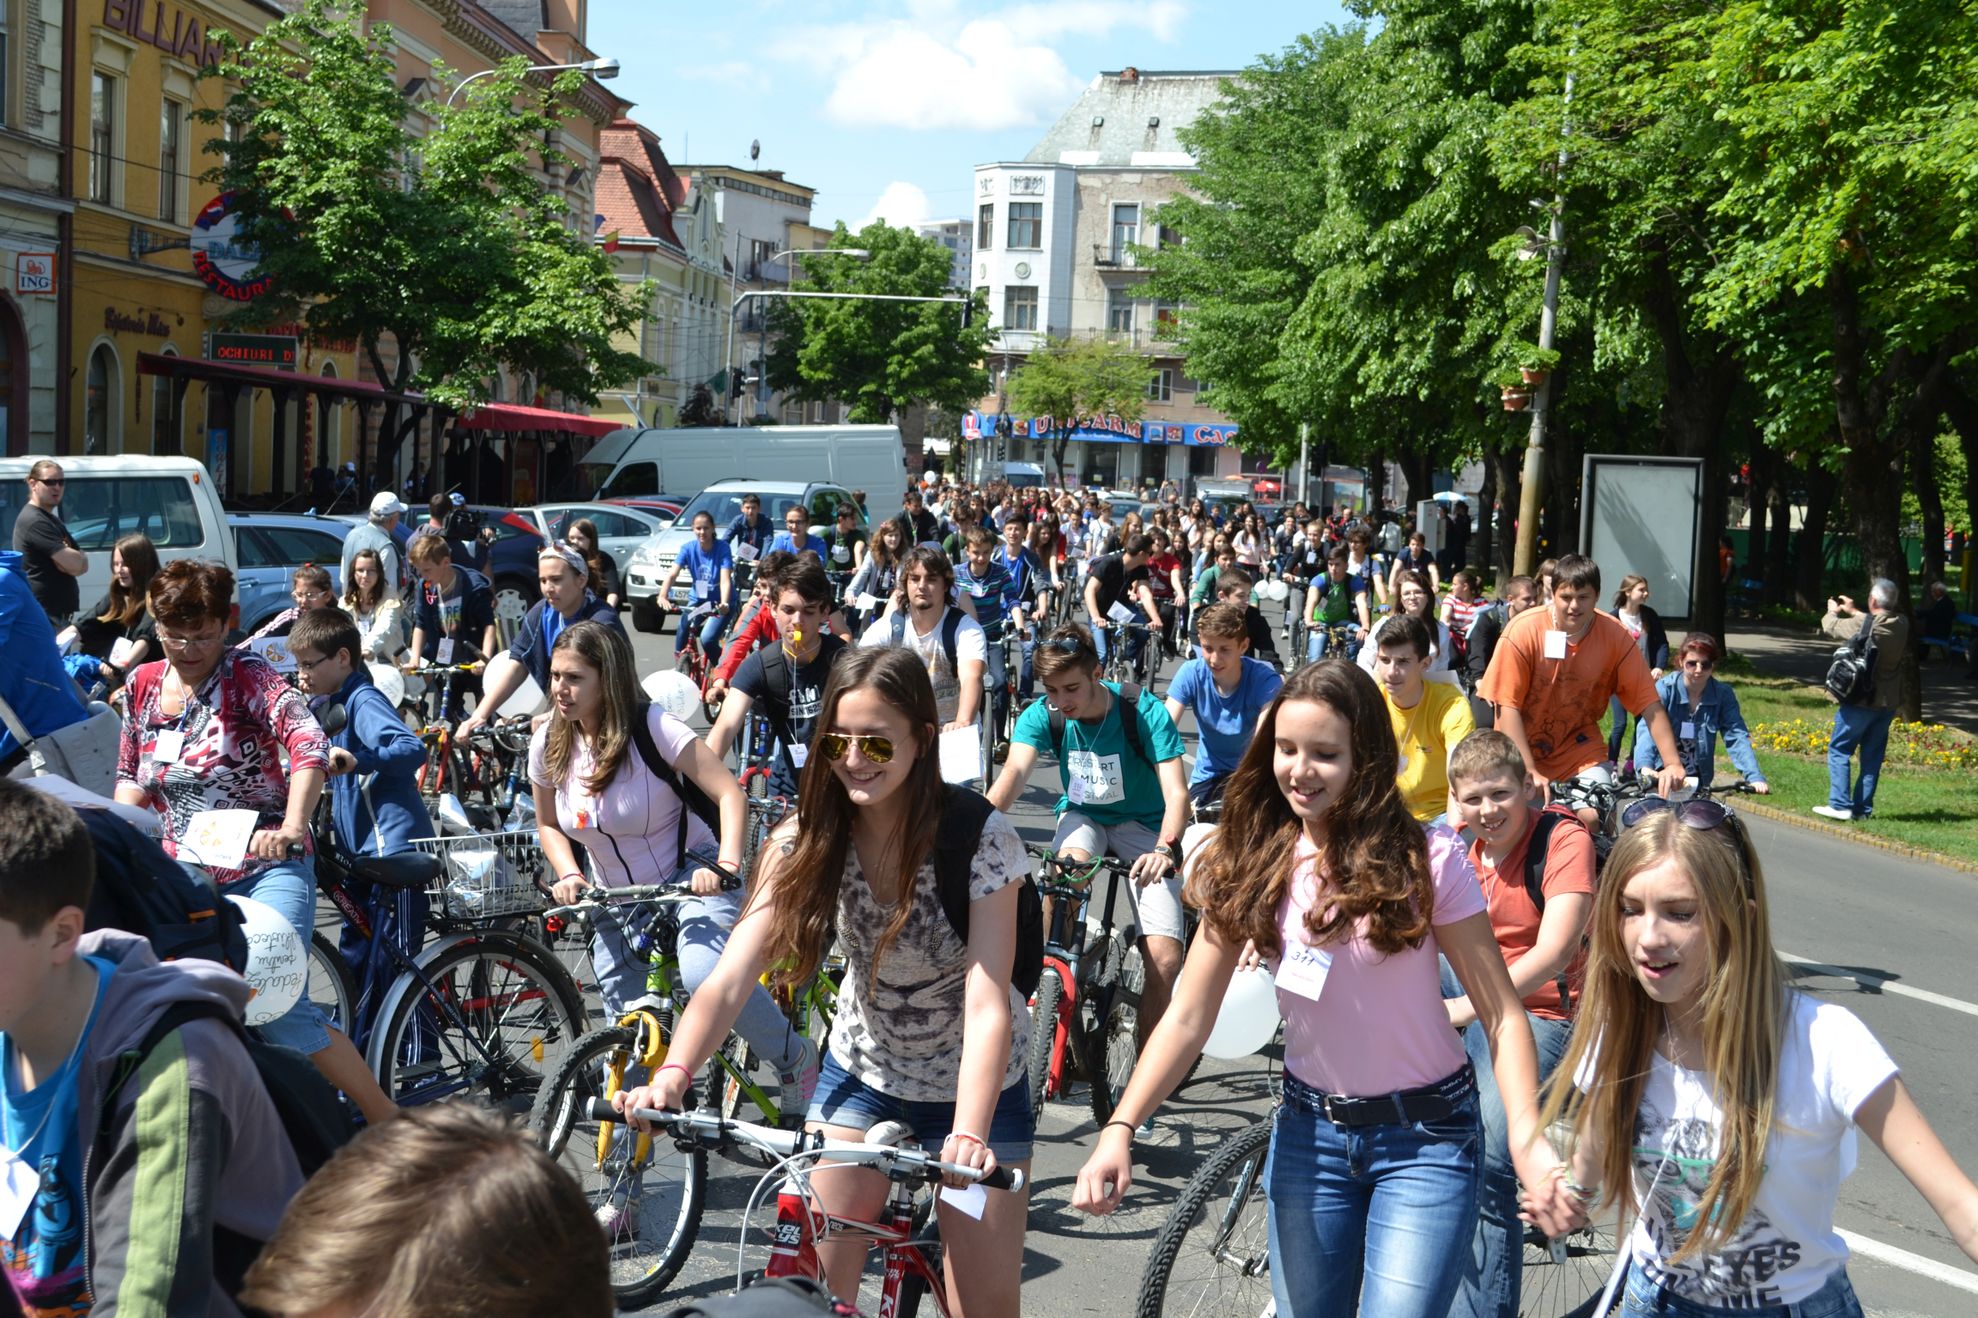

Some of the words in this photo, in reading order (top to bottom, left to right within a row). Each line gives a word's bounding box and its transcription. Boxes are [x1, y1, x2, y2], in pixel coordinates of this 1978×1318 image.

[21, 276, 49, 289] ING
[217, 346, 273, 361] OCHIURI
[1080, 774, 1117, 786] MUSIC
